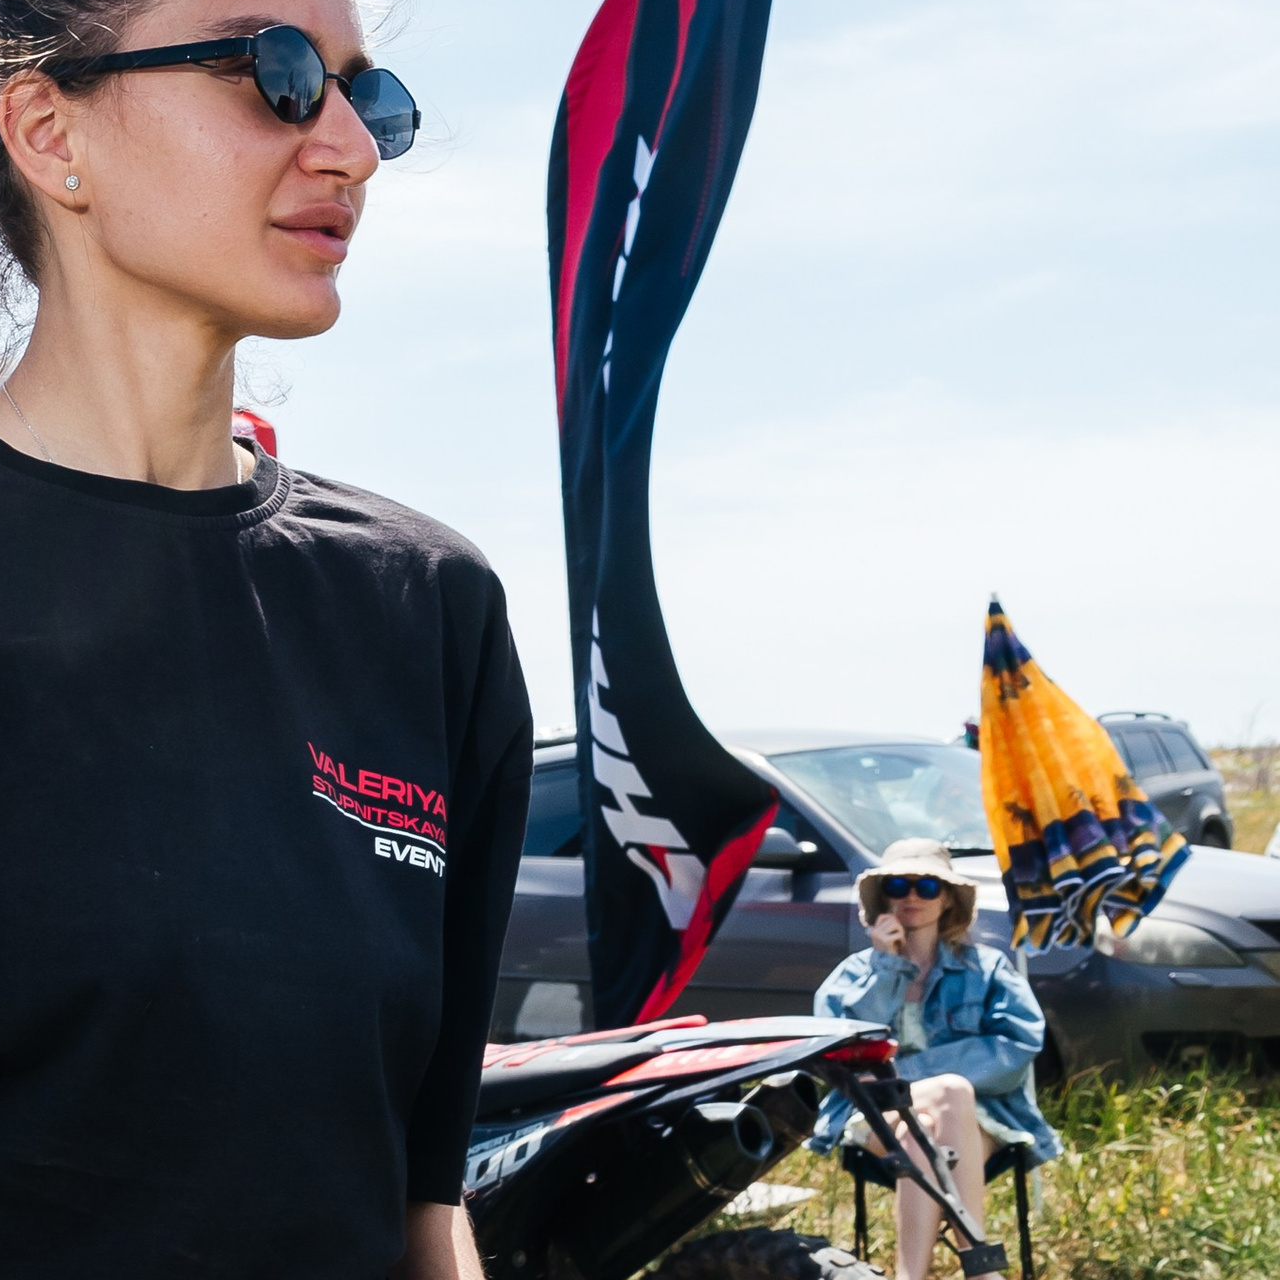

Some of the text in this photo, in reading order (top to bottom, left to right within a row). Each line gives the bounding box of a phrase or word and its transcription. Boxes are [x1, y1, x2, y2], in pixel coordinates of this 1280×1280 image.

[307, 741, 448, 822] VALERIYA
[312, 774, 447, 847] STUPNITSKAYA
[375, 836, 446, 877] EVENT
